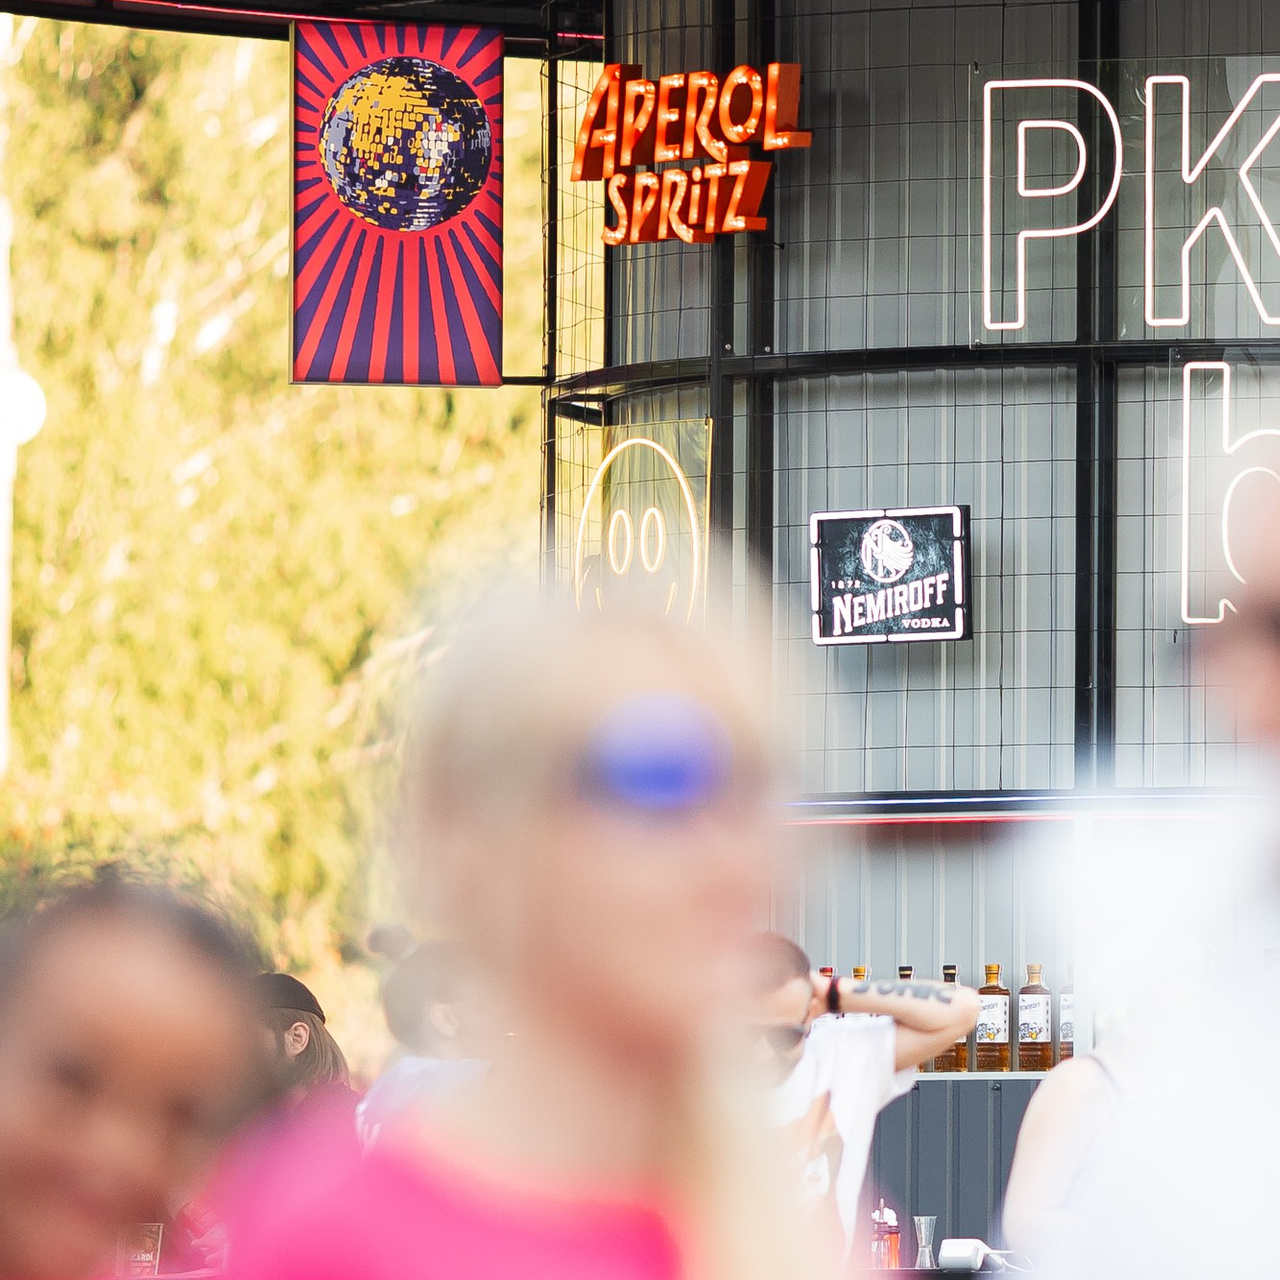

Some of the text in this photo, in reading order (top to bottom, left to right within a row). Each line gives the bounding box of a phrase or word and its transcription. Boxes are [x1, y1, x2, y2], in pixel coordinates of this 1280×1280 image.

[570, 63, 806, 182] APEROL
[832, 572, 950, 636] NEMIROFF
[901, 617, 950, 629] VODKA
